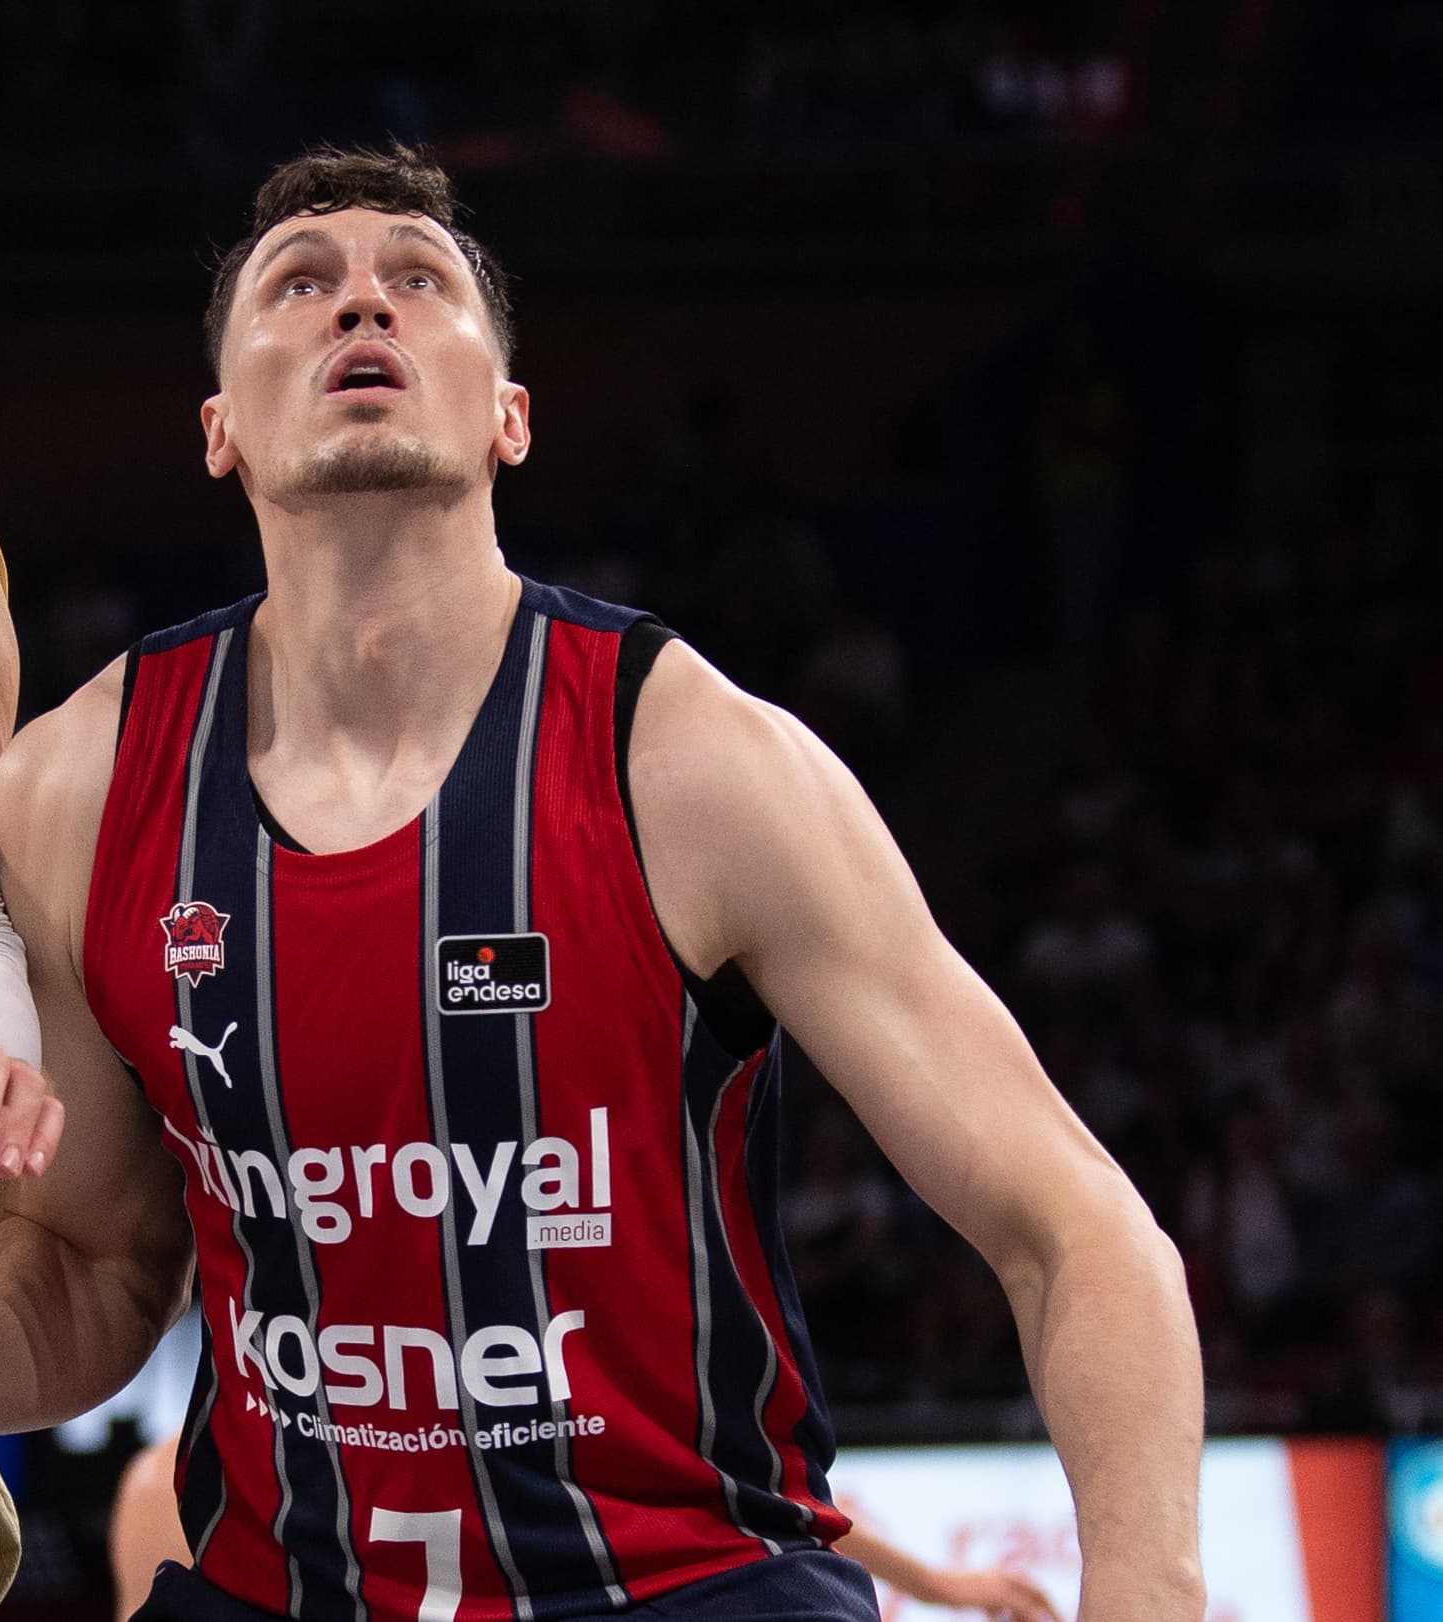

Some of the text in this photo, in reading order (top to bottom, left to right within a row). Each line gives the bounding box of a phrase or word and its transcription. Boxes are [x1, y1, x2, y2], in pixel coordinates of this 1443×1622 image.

[447, 960, 490, 984] liga
[447, 980, 541, 1003] endesa
[229, 1296, 585, 1411] kosner
[296, 1411, 606, 1453] Climatización eficiente
[368, 1506, 462, 1622] 7
